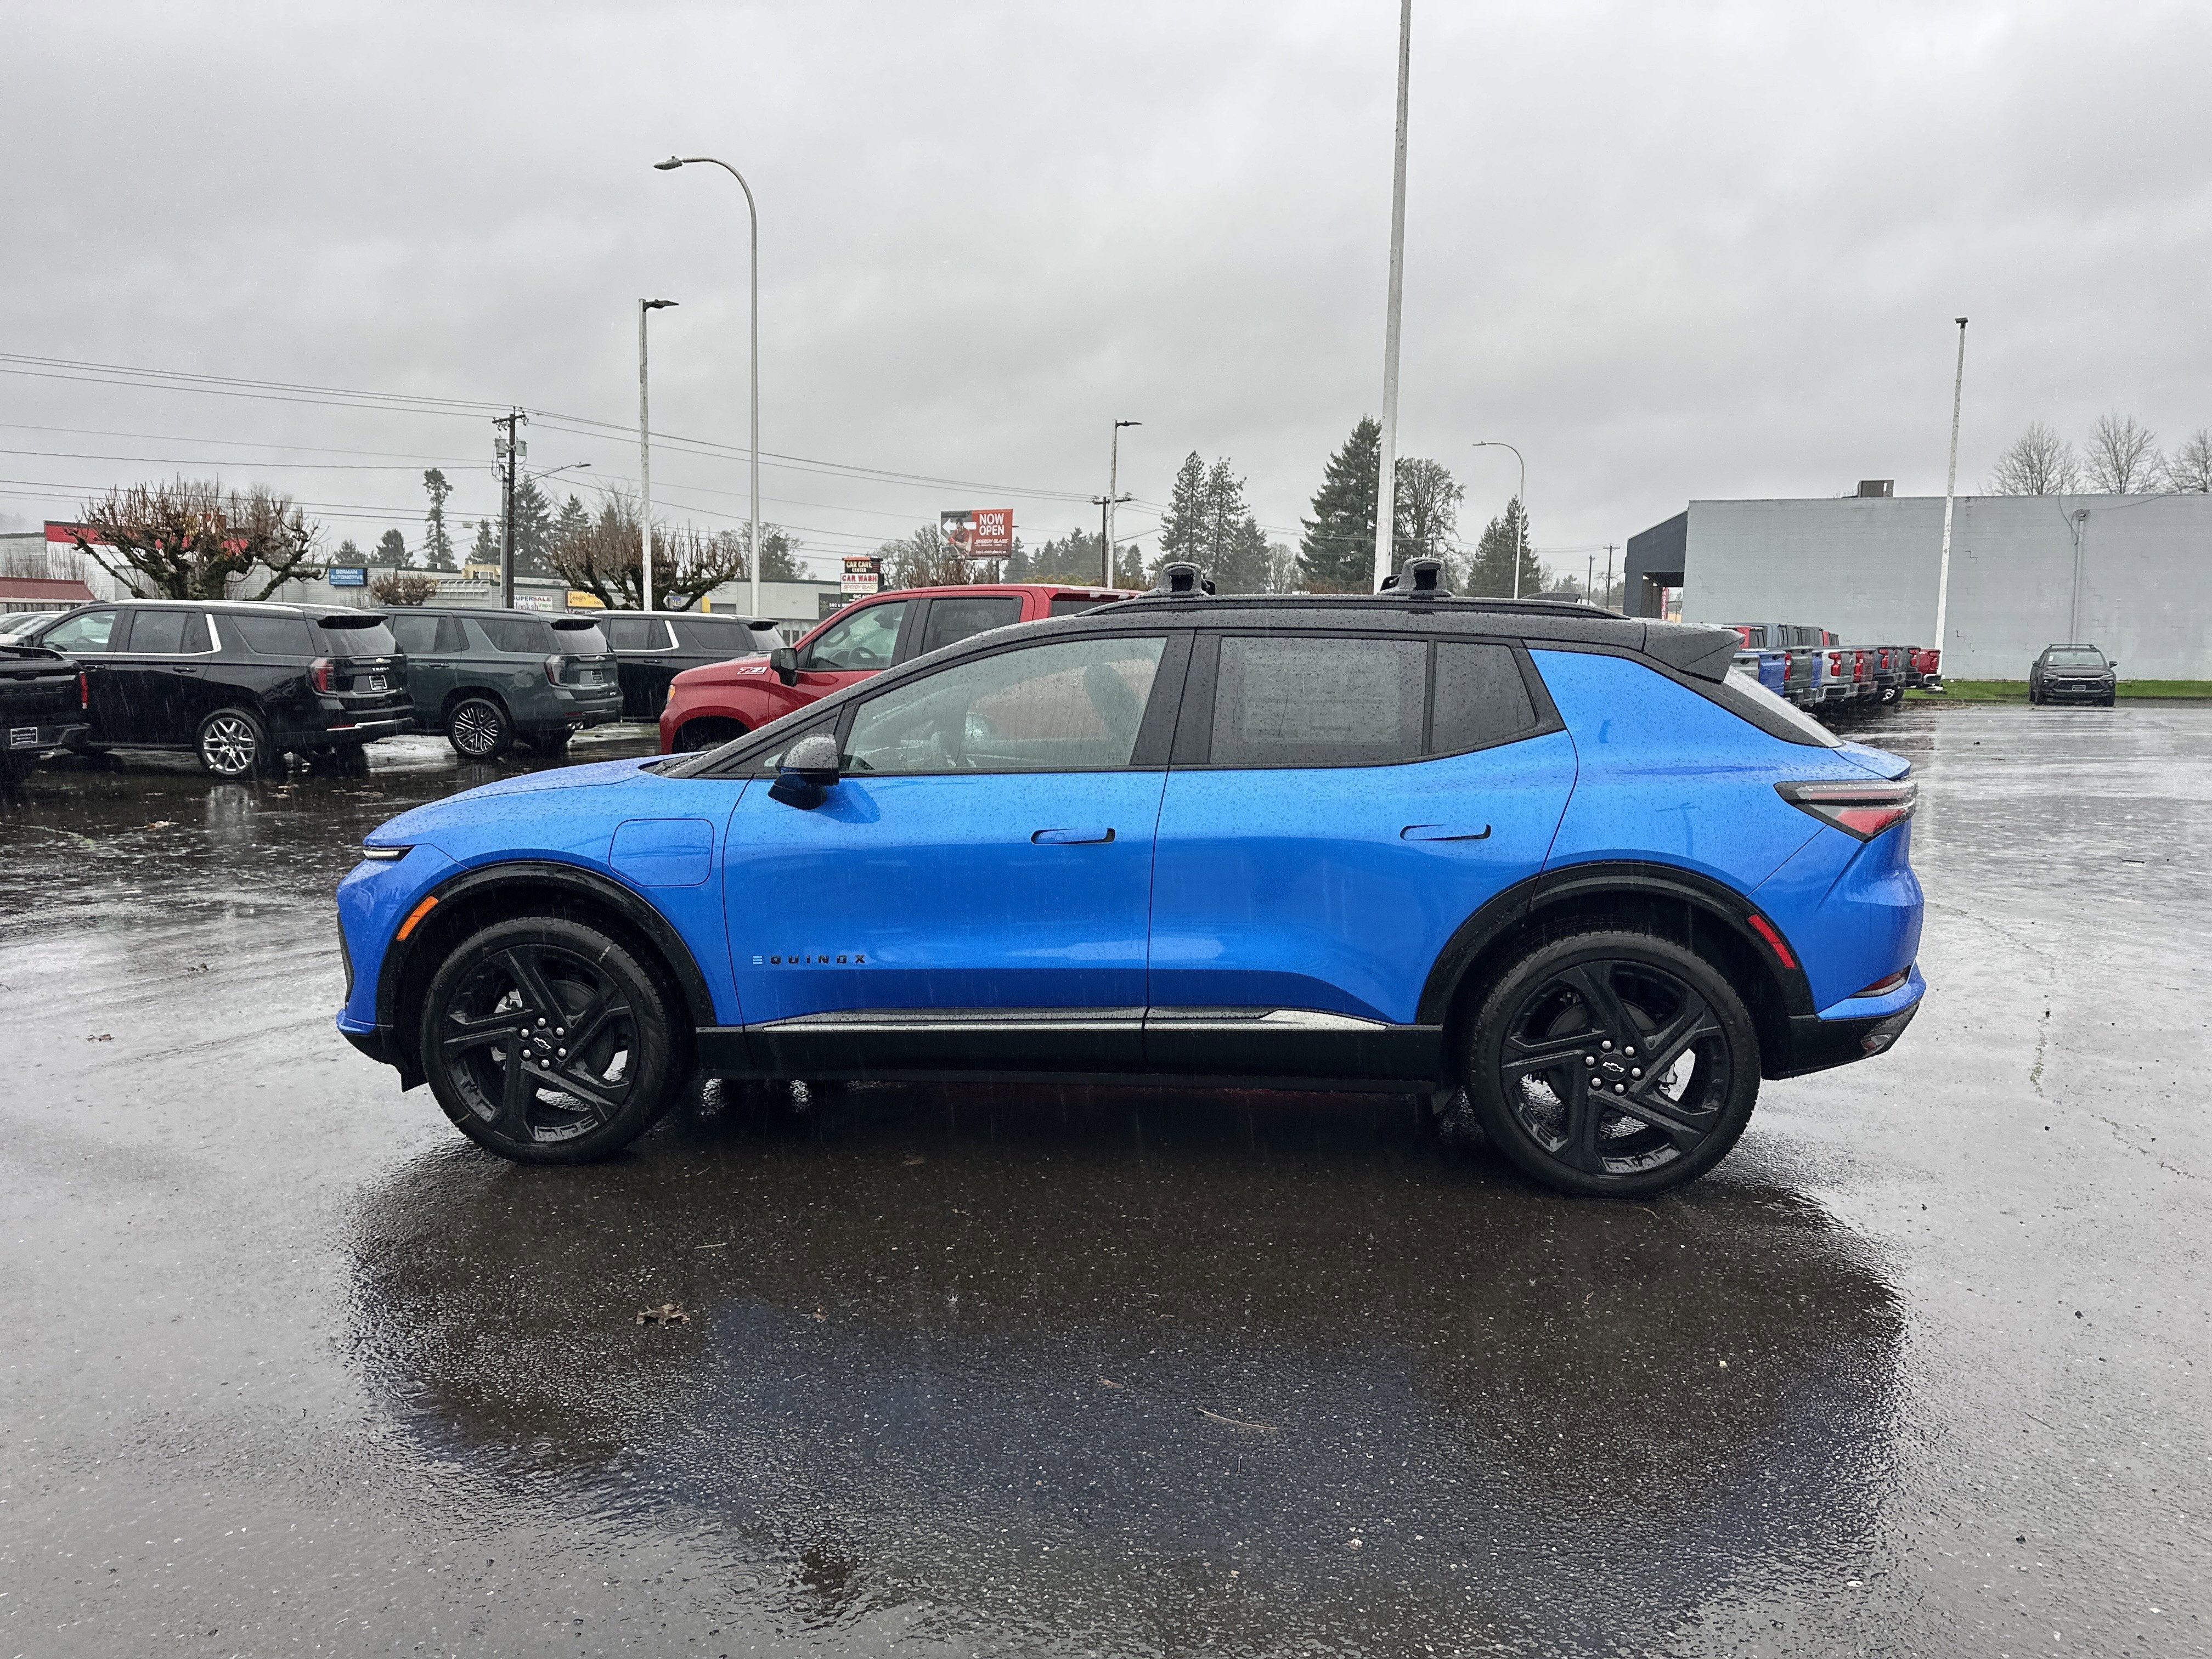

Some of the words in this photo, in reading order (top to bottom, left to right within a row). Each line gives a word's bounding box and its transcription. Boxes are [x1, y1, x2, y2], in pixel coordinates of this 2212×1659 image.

[979, 513, 1005, 525] NOW
[979, 525, 1005, 536] OPEN
[752, 955, 866, 965] EQUINOX
